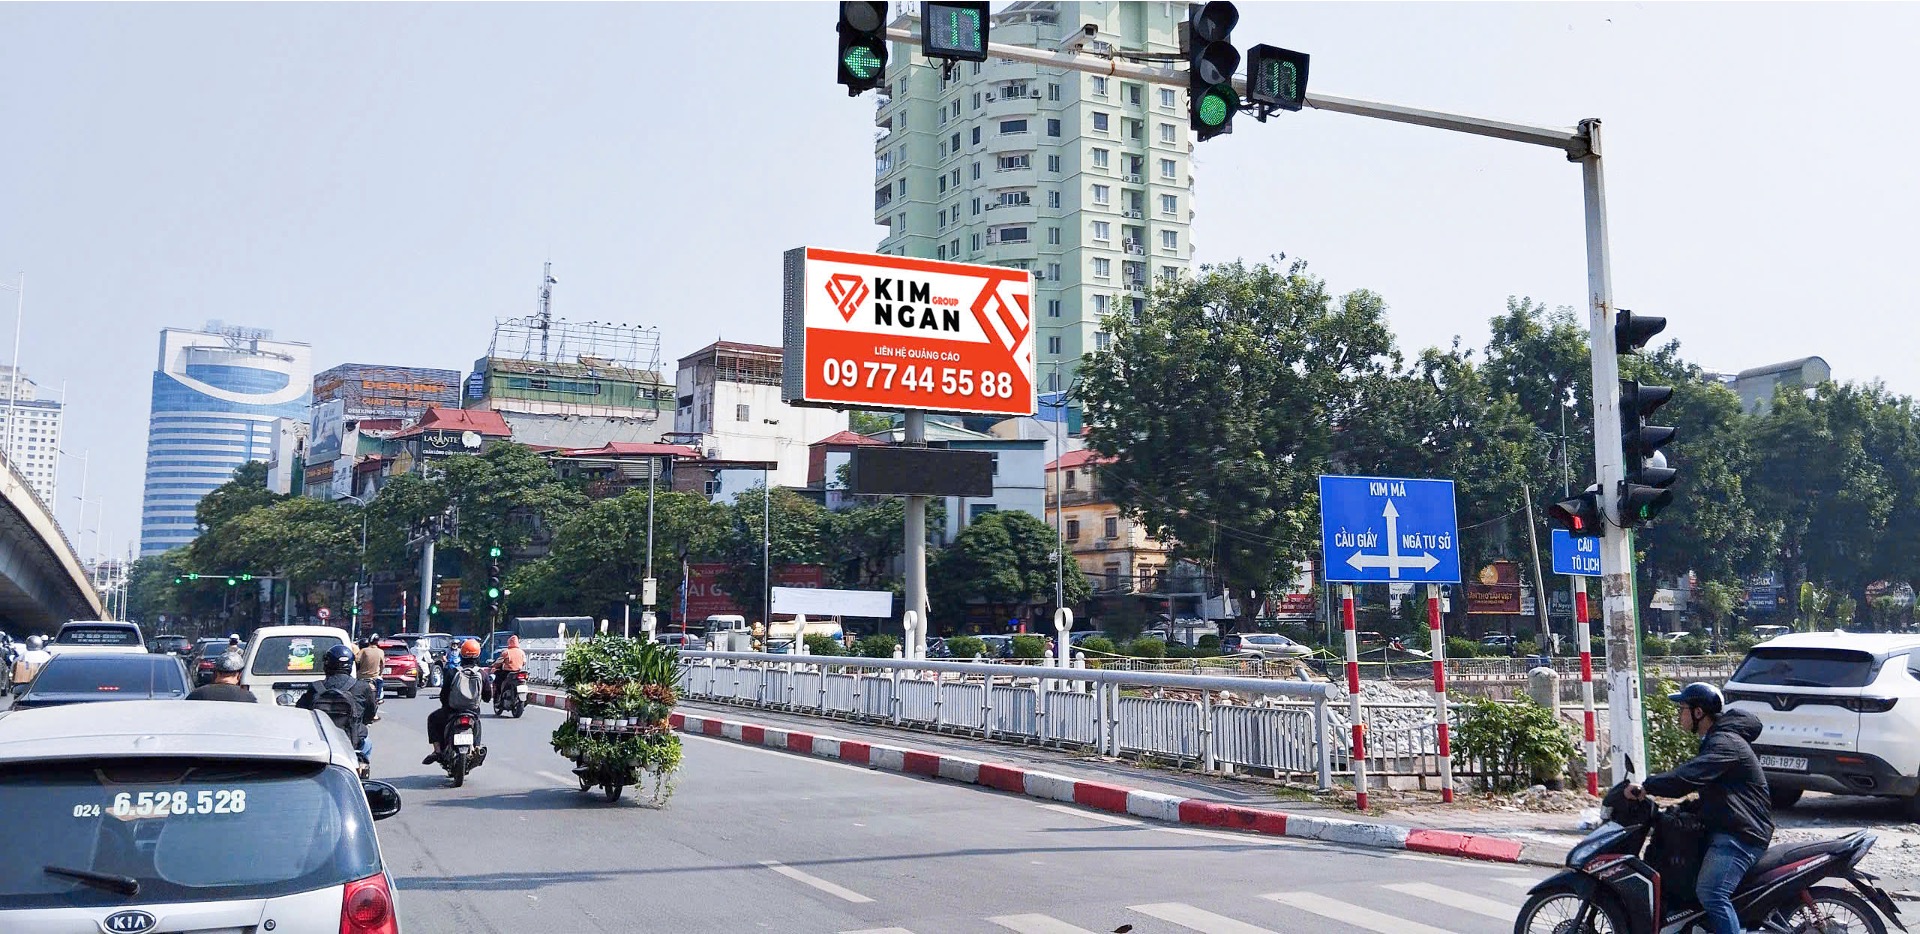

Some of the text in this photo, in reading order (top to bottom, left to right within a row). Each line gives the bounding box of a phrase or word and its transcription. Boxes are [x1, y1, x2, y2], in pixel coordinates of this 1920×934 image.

[951, 9, 980, 49] 17
[1273, 61, 1297, 99] 17
[875, 277, 930, 305] KIM
[931, 296, 959, 307] GROUP
[875, 302, 960, 332] NGAN
[874, 345, 960, 362] LIÊN HỆ QUẢNG CÁO
[823, 358, 1013, 399] 09 77 44 55 88
[1370, 480, 1406, 497] KIM MÃ
[1335, 526, 1378, 548] CẦU GIẤY
[1402, 531, 1451, 550] NGÃ TƯ SỞ
[1571, 554, 1600, 573] TÔ LỊCH
[73, 789, 247, 817] 024 6.528.528
[113, 915, 147, 930] KIA
[1666, 909, 1694, 923] HONDA
